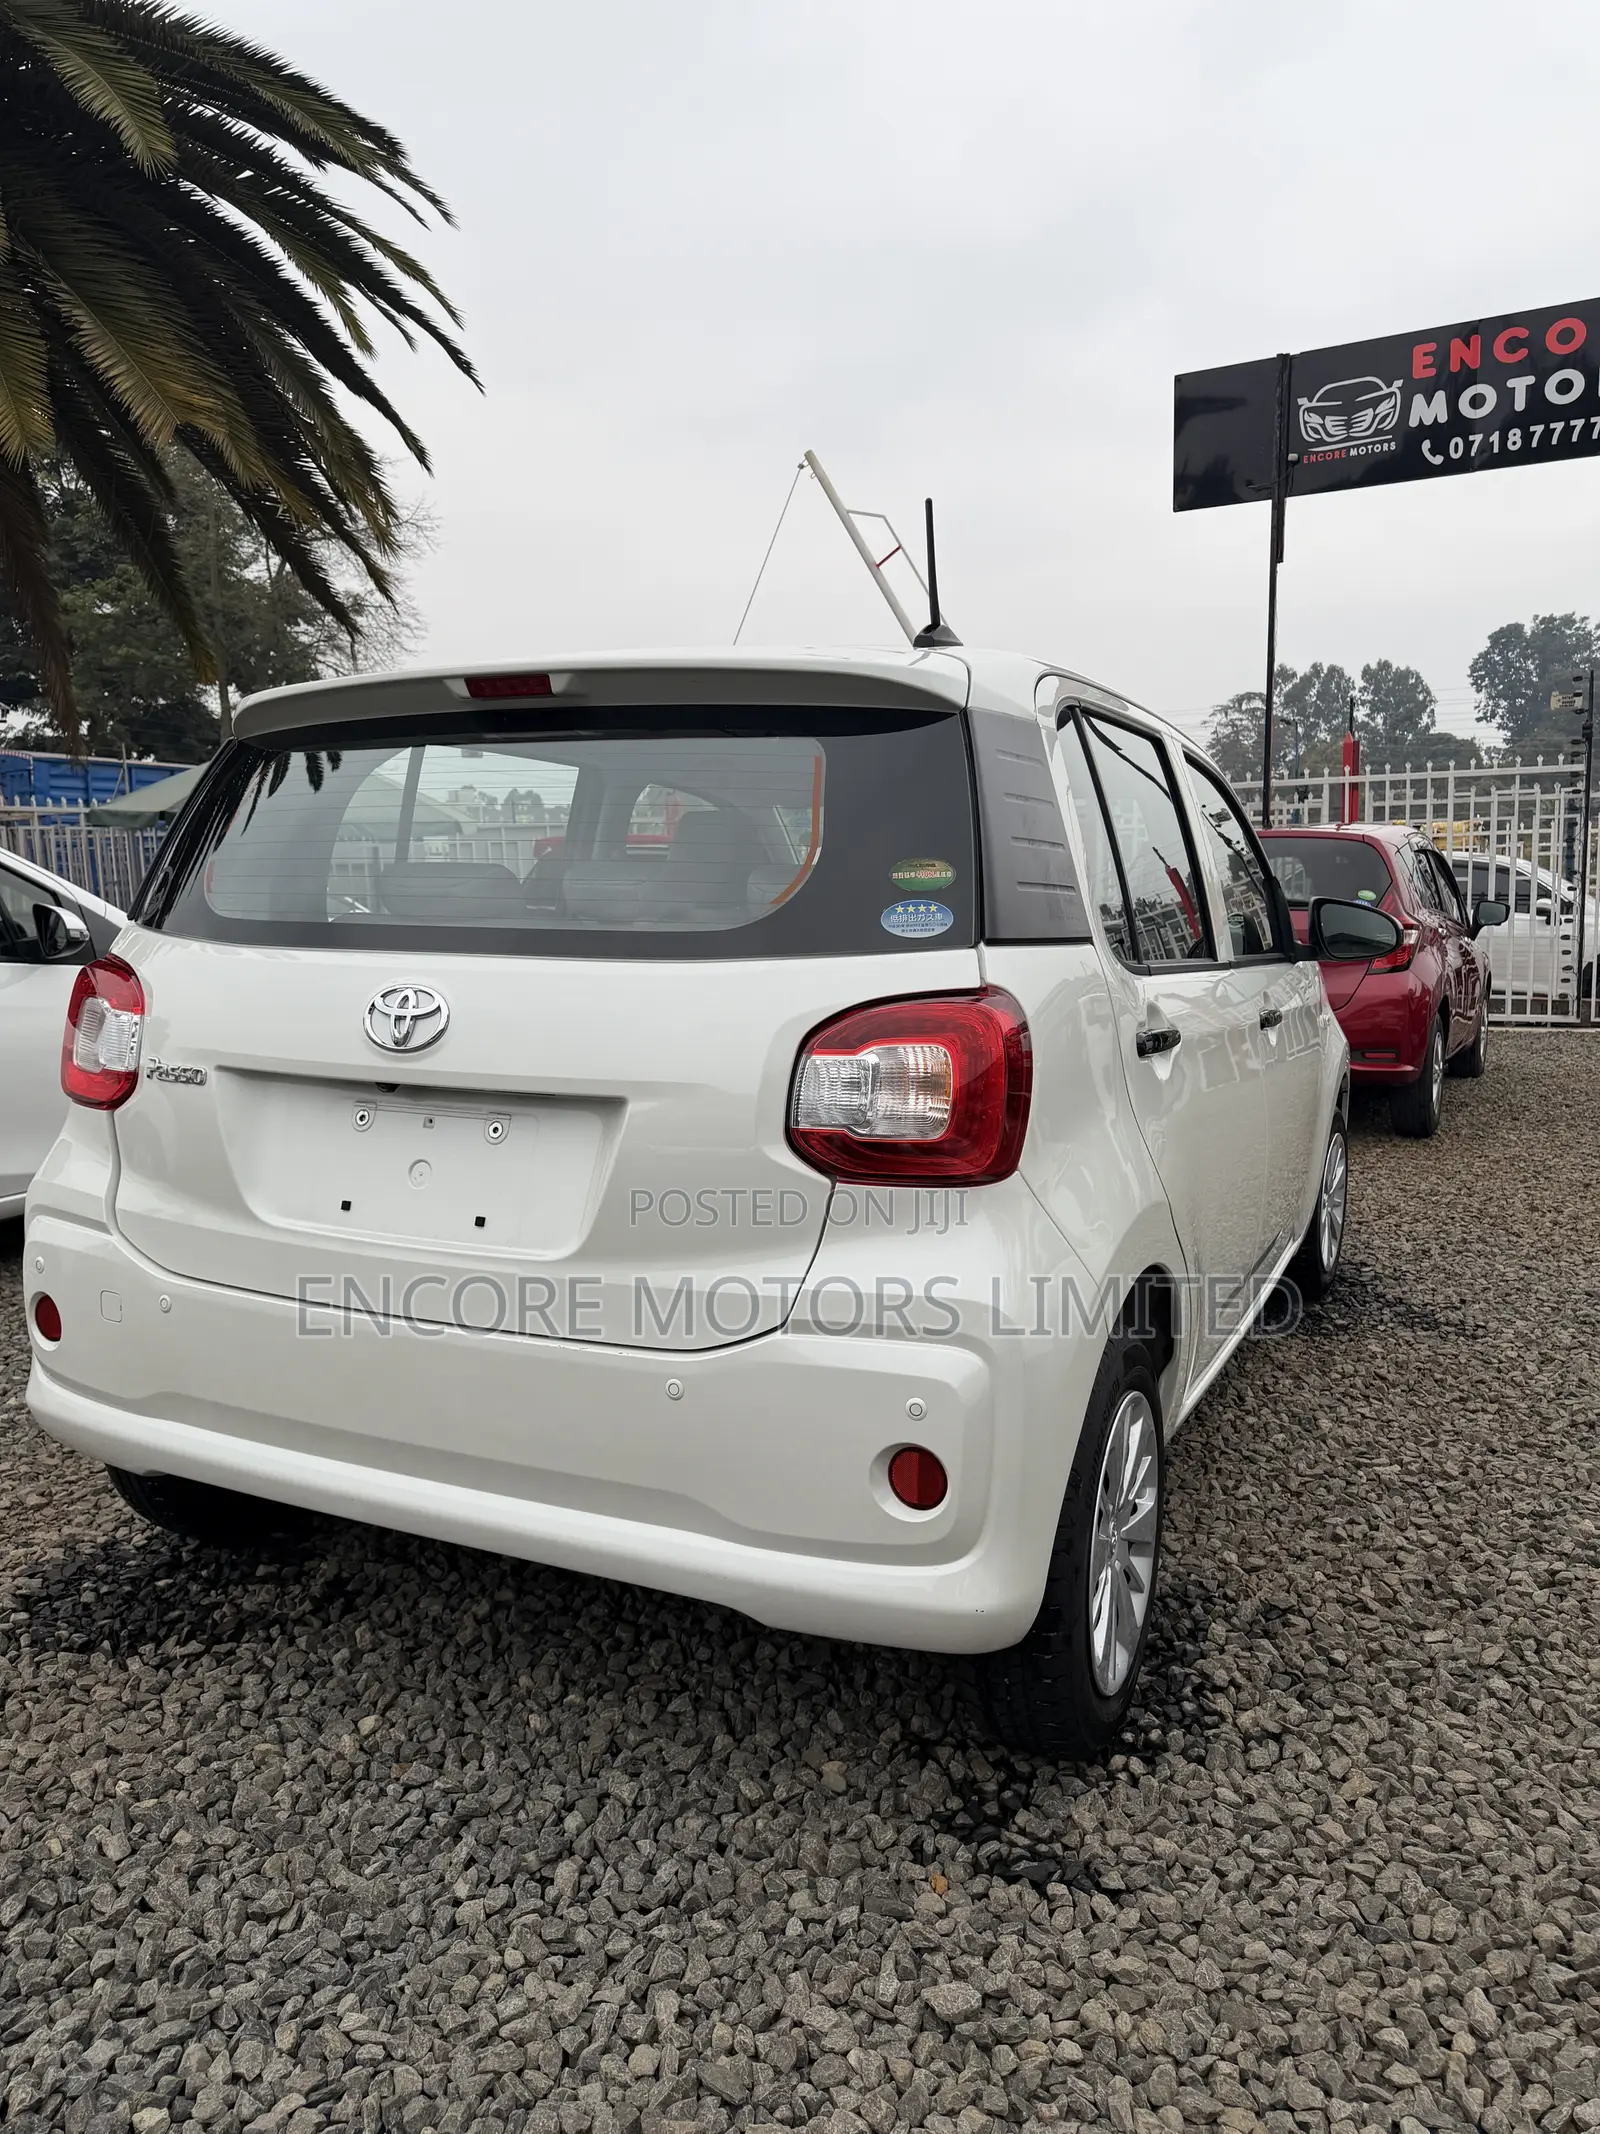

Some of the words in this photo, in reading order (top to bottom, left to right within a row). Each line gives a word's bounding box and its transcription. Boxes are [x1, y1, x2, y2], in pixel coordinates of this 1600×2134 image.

[1412, 317, 1587, 379] ENCO
[1408, 368, 1600, 427] MOTO
[1303, 449, 1347, 464] ENCORE
[1349, 441, 1396, 457] MOTORS
[1449, 416, 1600, 459] 07187777
[890, 913, 944, 923] 低排出ガス車
